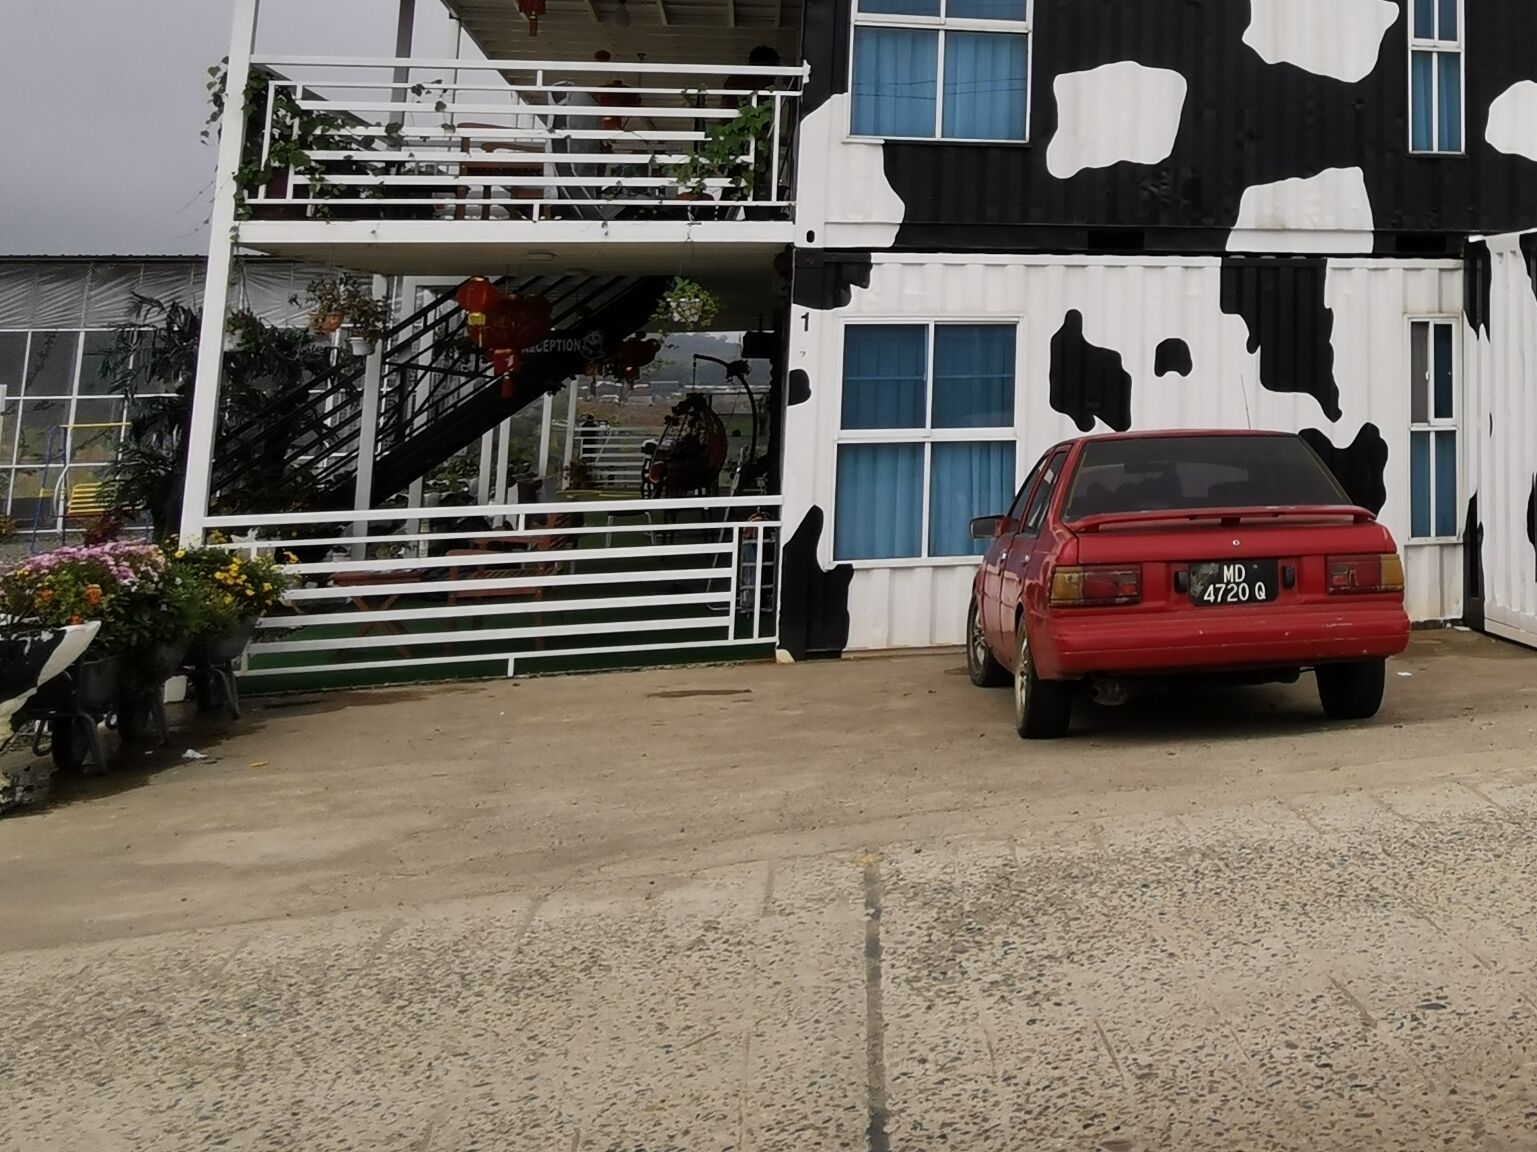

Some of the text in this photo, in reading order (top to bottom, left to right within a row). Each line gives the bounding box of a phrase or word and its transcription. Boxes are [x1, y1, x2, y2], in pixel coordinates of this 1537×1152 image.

[1223, 564, 1246, 583] MD
[1203, 581, 1267, 603] 4720 Q
